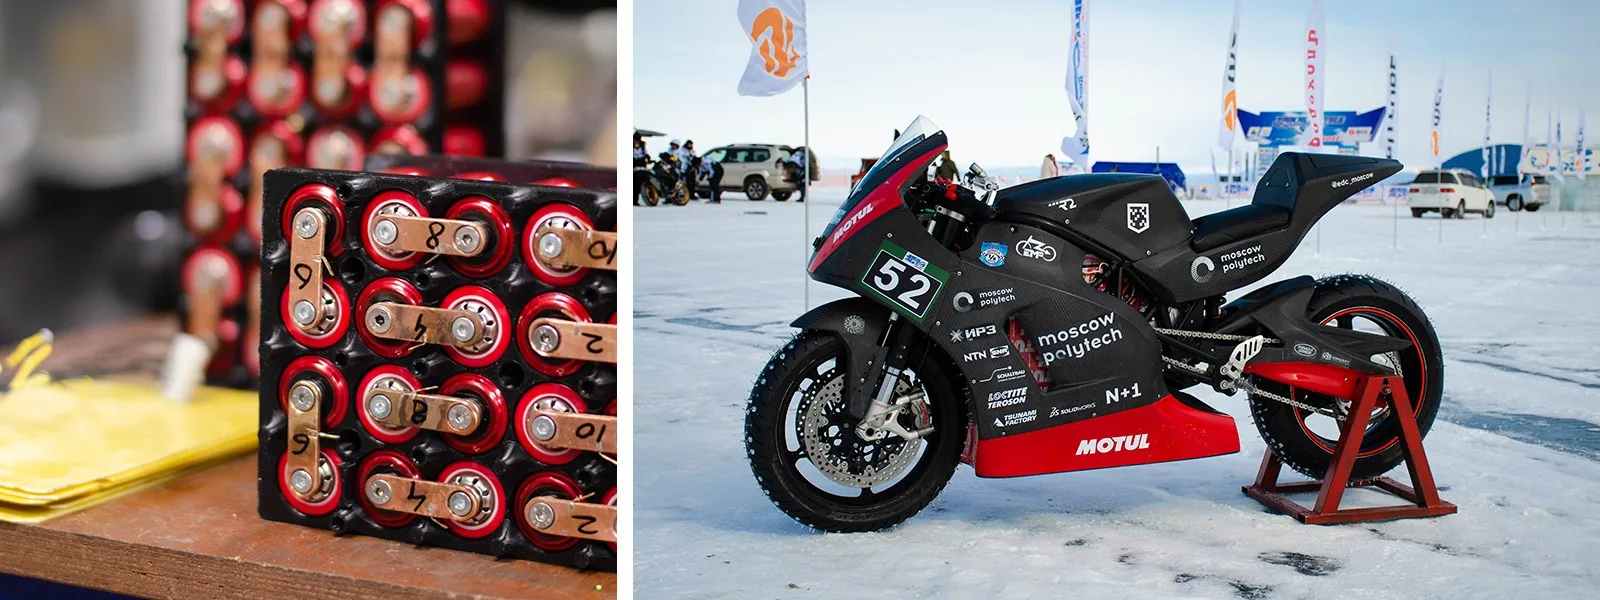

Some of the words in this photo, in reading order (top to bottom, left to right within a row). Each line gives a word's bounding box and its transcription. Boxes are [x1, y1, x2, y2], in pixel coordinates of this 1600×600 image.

[833, 203, 874, 243] MOTUL
[426, 221, 445, 249] 8
[1221, 245, 1261, 262] moscow
[1223, 254, 1265, 273] polytech
[874, 258, 931, 310] 52
[979, 287, 1014, 298] moscow
[980, 294, 1015, 307] polytech
[1037, 312, 1115, 347] moscow
[581, 332, 603, 354] 2
[1042, 328, 1123, 366] polytech
[964, 350, 987, 362] NTN
[988, 387, 1028, 401] LOCTITE
[988, 396, 1027, 409] TEROSON
[1105, 382, 1142, 404] N+1
[1004, 409, 1037, 420] TSUNAMI
[1060, 402, 1097, 415] SOLIDWORKS
[1005, 415, 1037, 426] FACTORY
[1075, 433, 1150, 456] MOTUL
[571, 514, 598, 534] 2
